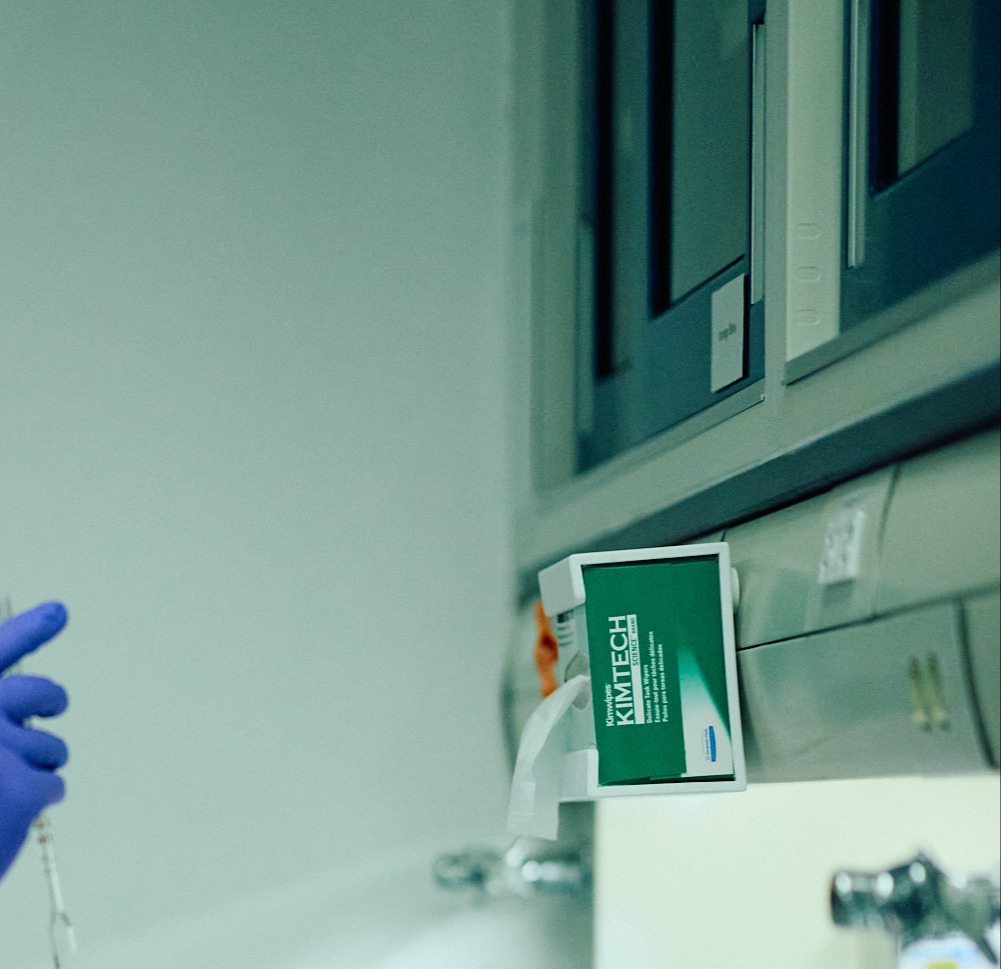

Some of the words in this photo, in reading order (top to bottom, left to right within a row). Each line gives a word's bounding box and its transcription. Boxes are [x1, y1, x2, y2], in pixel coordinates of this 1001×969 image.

[608, 615, 634, 726] KIMTECH
[631, 639, 639, 666] SCIENCE
[604, 684, 614, 726] Kimwipes
